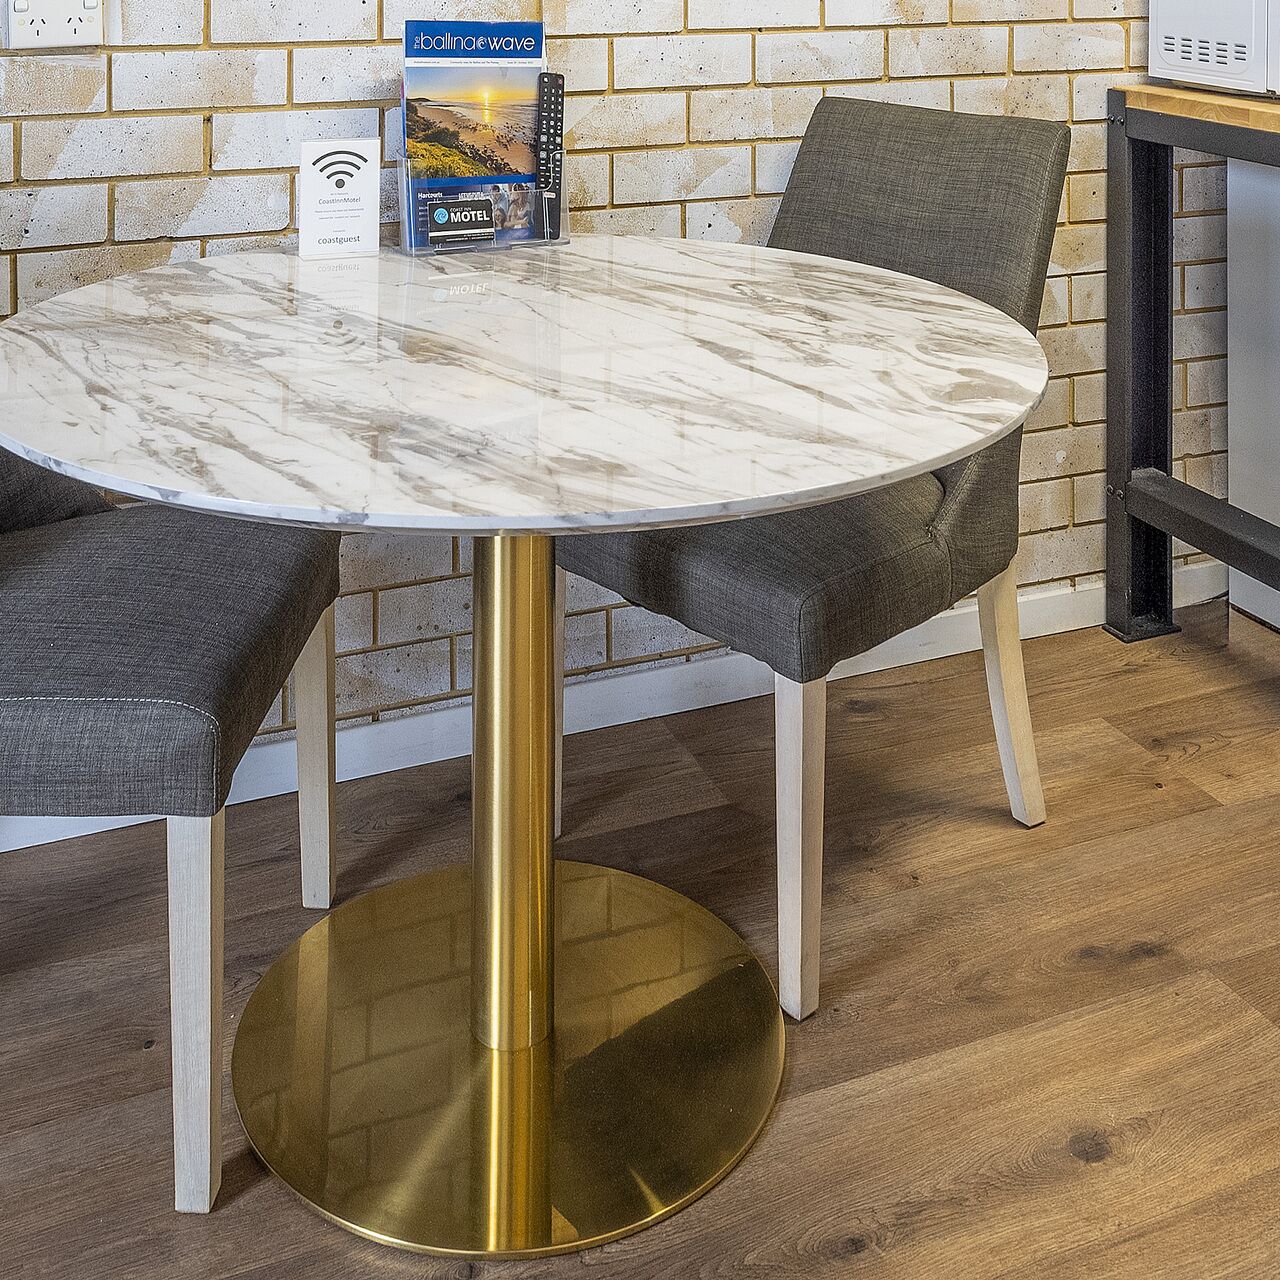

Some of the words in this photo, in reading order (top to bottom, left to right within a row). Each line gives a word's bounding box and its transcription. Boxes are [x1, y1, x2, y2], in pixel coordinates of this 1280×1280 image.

[420, 32, 475, 50] ballina
[488, 37, 535, 51] wave
[450, 210, 490, 223] MOTEL
[317, 235, 361, 245] coastguest
